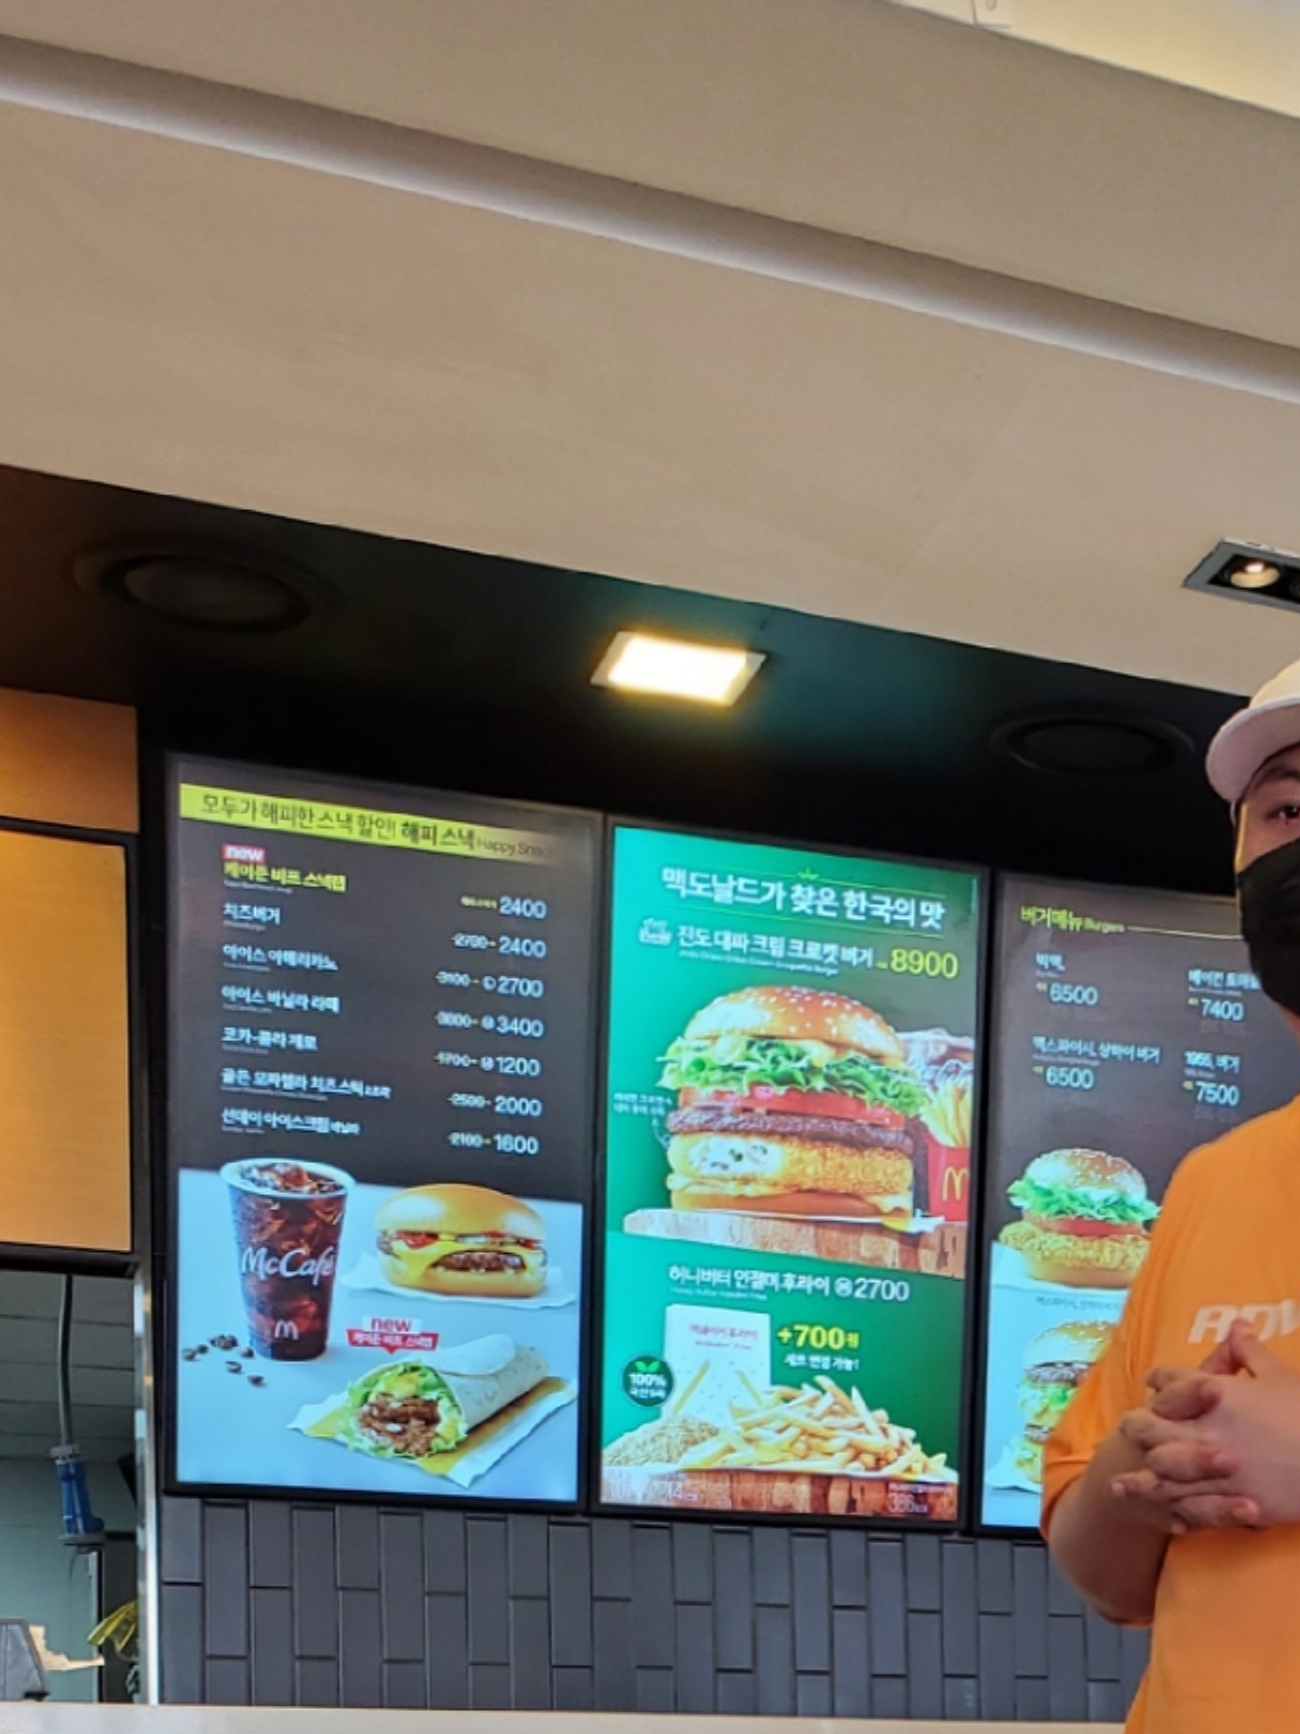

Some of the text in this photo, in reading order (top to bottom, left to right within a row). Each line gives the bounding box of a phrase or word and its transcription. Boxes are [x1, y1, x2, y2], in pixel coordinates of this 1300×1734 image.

[202, 793, 257, 823] 모두가
[260, 800, 314, 831] 해피한
[316, 810, 353, 836] 스낵
[357, 813, 397, 840] 할인!
[401, 820, 437, 847] 해피
[440, 826, 475, 850] 스낵
[226, 846, 265, 861] new
[499, 895, 547, 919] 2400
[661, 866, 947, 931] 맥도날드가 찾은 한국의 맛
[223, 902, 281, 925] 치즈버거
[222, 944, 268, 963] 아이스
[498, 935, 547, 958] 2400
[677, 923, 714, 948] 진도
[713, 929, 751, 954] 대파
[750, 933, 787, 959] 크림
[786, 938, 839, 965] 크로켓
[840, 945, 875, 969] 버거
[889, 947, 960, 980] 8900
[221, 985, 266, 1004] 아이스
[497, 975, 544, 998] 2700
[1049, 982, 1099, 1006] 6500
[1200, 997, 1244, 1022] 7400
[497, 1014, 544, 1037] 3400
[496, 1056, 542, 1076] 1200
[1045, 1065, 1095, 1090] 6500
[1194, 1080, 1241, 1107] 7500
[494, 1095, 543, 1117] 2000
[222, 1107, 263, 1127] 선데이
[263, 1111, 331, 1134] 아이스크림
[493, 1133, 540, 1155] 1600
[668, 1264, 732, 1288] 허니버터
[733, 1268, 781, 1292] 인절미
[780, 1271, 831, 1297] 후라이
[853, 1276, 911, 1303] 2700
[370, 1316, 413, 1334] new
[628, 1372, 668, 1391] 100%
